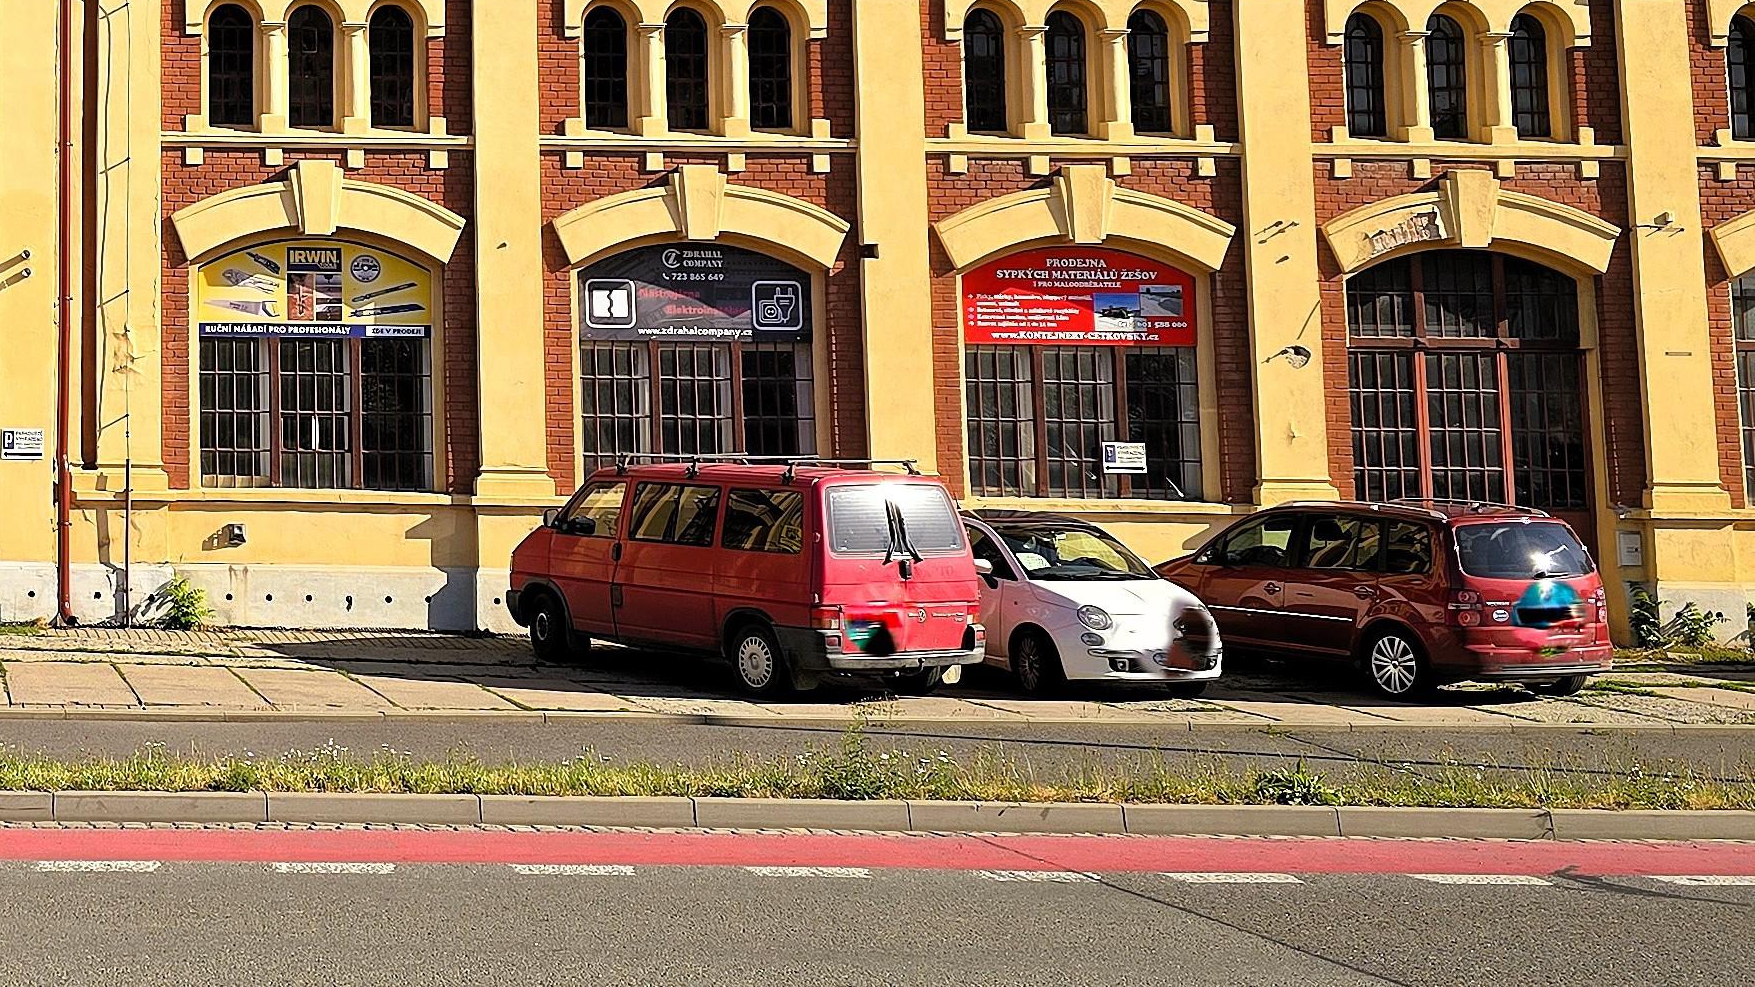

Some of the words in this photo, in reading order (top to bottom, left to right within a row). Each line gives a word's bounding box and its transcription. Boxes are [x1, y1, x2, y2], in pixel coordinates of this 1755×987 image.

[682, 250, 723, 258] ZDRAHAL
[683, 259, 724, 268] COMPANY
[1046, 258, 1107, 268] PRODEJNA
[671, 272, 688, 281] 723
[707, 273, 725, 281] 649
[996, 268, 1049, 279] SYPKÝCH
[1052, 269, 1118, 280] MATERIÁLŮ
[1120, 268, 1158, 280] ŽEŠOV
[205, 324, 232, 333] RUČNÍ
[233, 323, 267, 333] NÁŘADÍ
[268, 325, 287, 333] PRO
[637, 325, 753, 339] www.zdrahalcompany.cz
